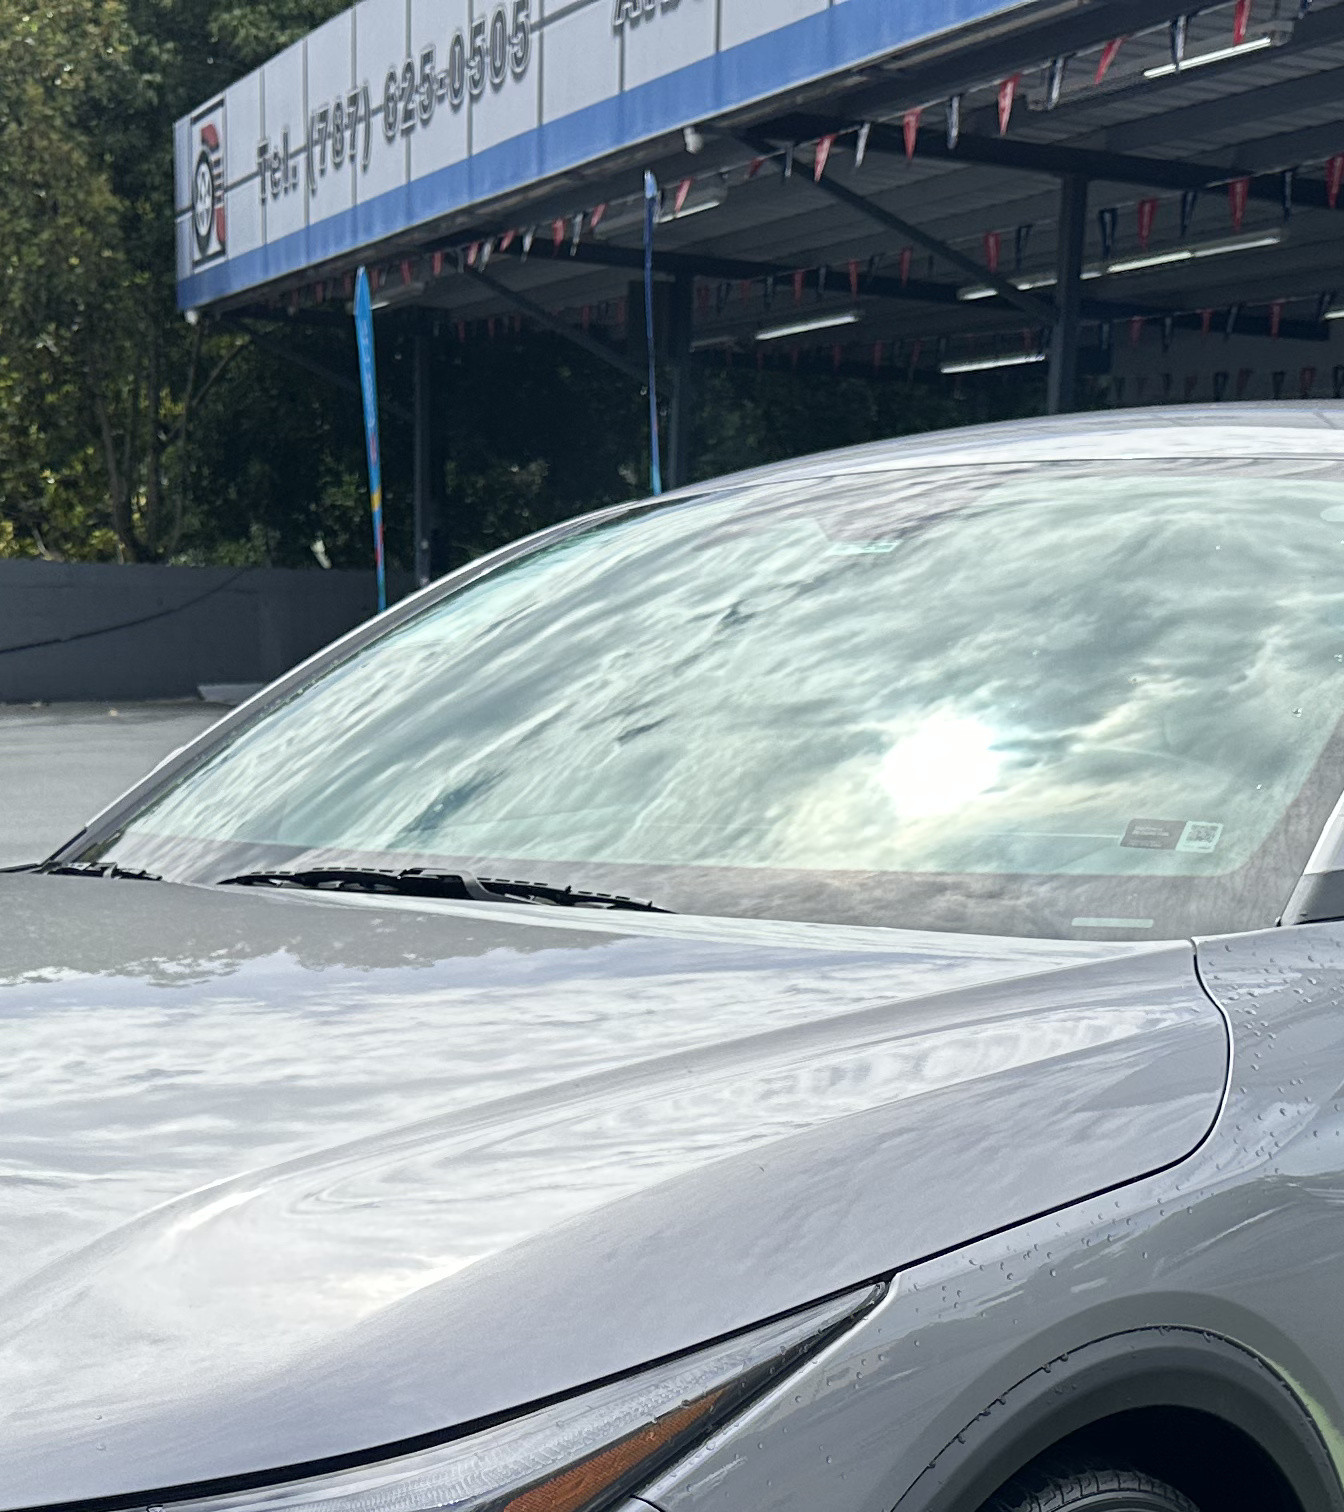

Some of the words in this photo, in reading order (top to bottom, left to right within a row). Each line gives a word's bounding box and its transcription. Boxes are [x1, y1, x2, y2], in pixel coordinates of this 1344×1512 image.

[257, 126, 299, 203] Tel.
[307, 82, 372, 196] (787)
[382, 0, 531, 141] 625-0505
